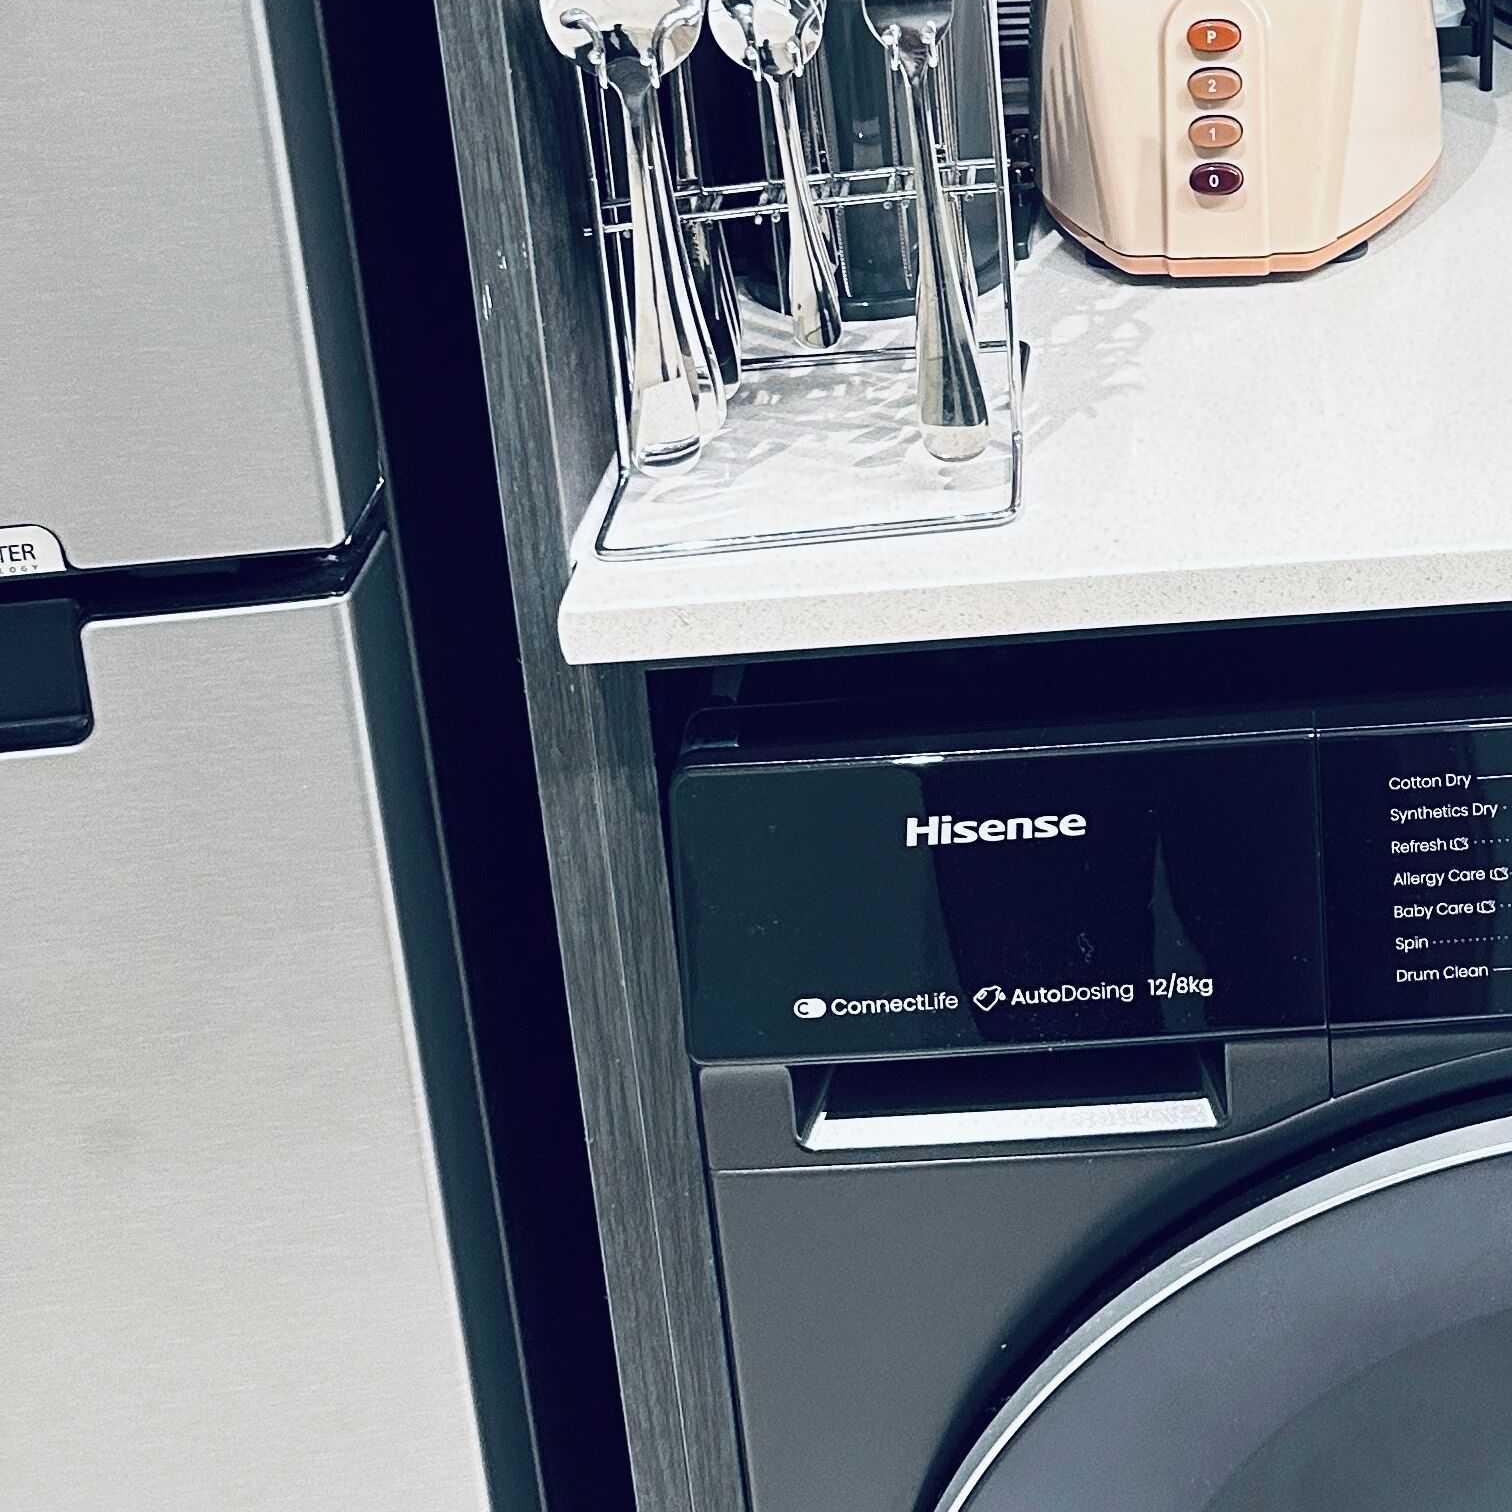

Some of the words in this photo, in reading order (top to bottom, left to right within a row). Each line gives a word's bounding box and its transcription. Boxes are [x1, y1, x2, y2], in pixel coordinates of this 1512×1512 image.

[1206, 29, 1217, 44] P
[1207, 78, 1217, 93] 2
[1208, 126, 1216, 141] 1
[1388, 776, 1442, 790] Cotton
[1445, 773, 1472, 789] Dry
[1390, 804, 1469, 824] Synthetics
[1472, 802, 1499, 818] Dry
[905, 813, 1086, 847] Hisense
[1391, 838, 1447, 854] Refresh
[1393, 872, 1445, 887] Allergy
[1448, 869, 1486, 882] Care
[1393, 904, 1434, 920] Baby
[1436, 902, 1474, 915] Care
[1395, 935, 1429, 953] Spin
[1396, 968, 1440, 982] Drum
[1442, 965, 1489, 979] Clean
[1010, 981, 1134, 1006] AutoDosing
[1147, 972, 1214, 999] 12/8kg
[830, 991, 959, 1016] ConnectLife
